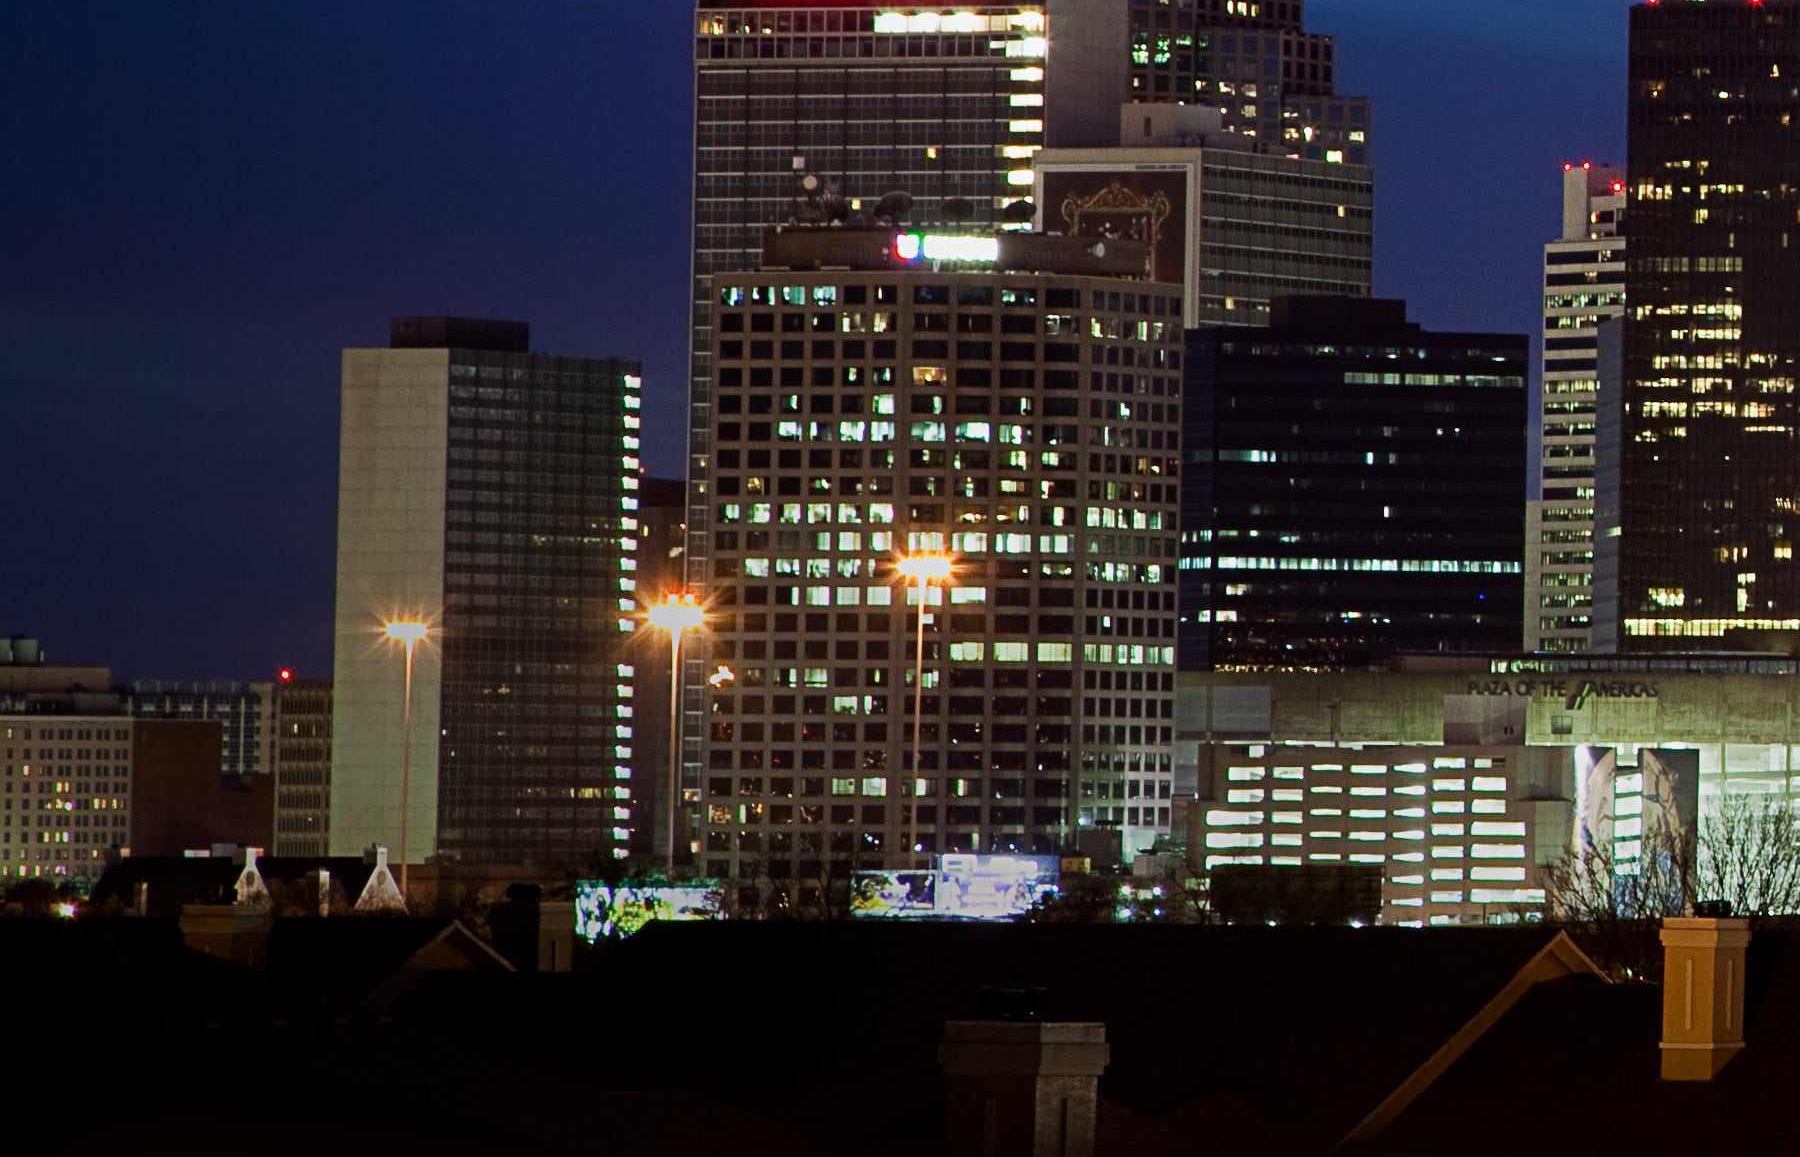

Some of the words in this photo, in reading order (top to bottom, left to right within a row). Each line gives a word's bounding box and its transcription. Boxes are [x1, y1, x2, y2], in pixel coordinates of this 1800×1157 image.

[1468, 681, 1511, 697] PLAZA
[1516, 681, 1536, 697] OF
[1541, 681, 1567, 697] THE
[1581, 680, 1659, 698] AMERICAS
